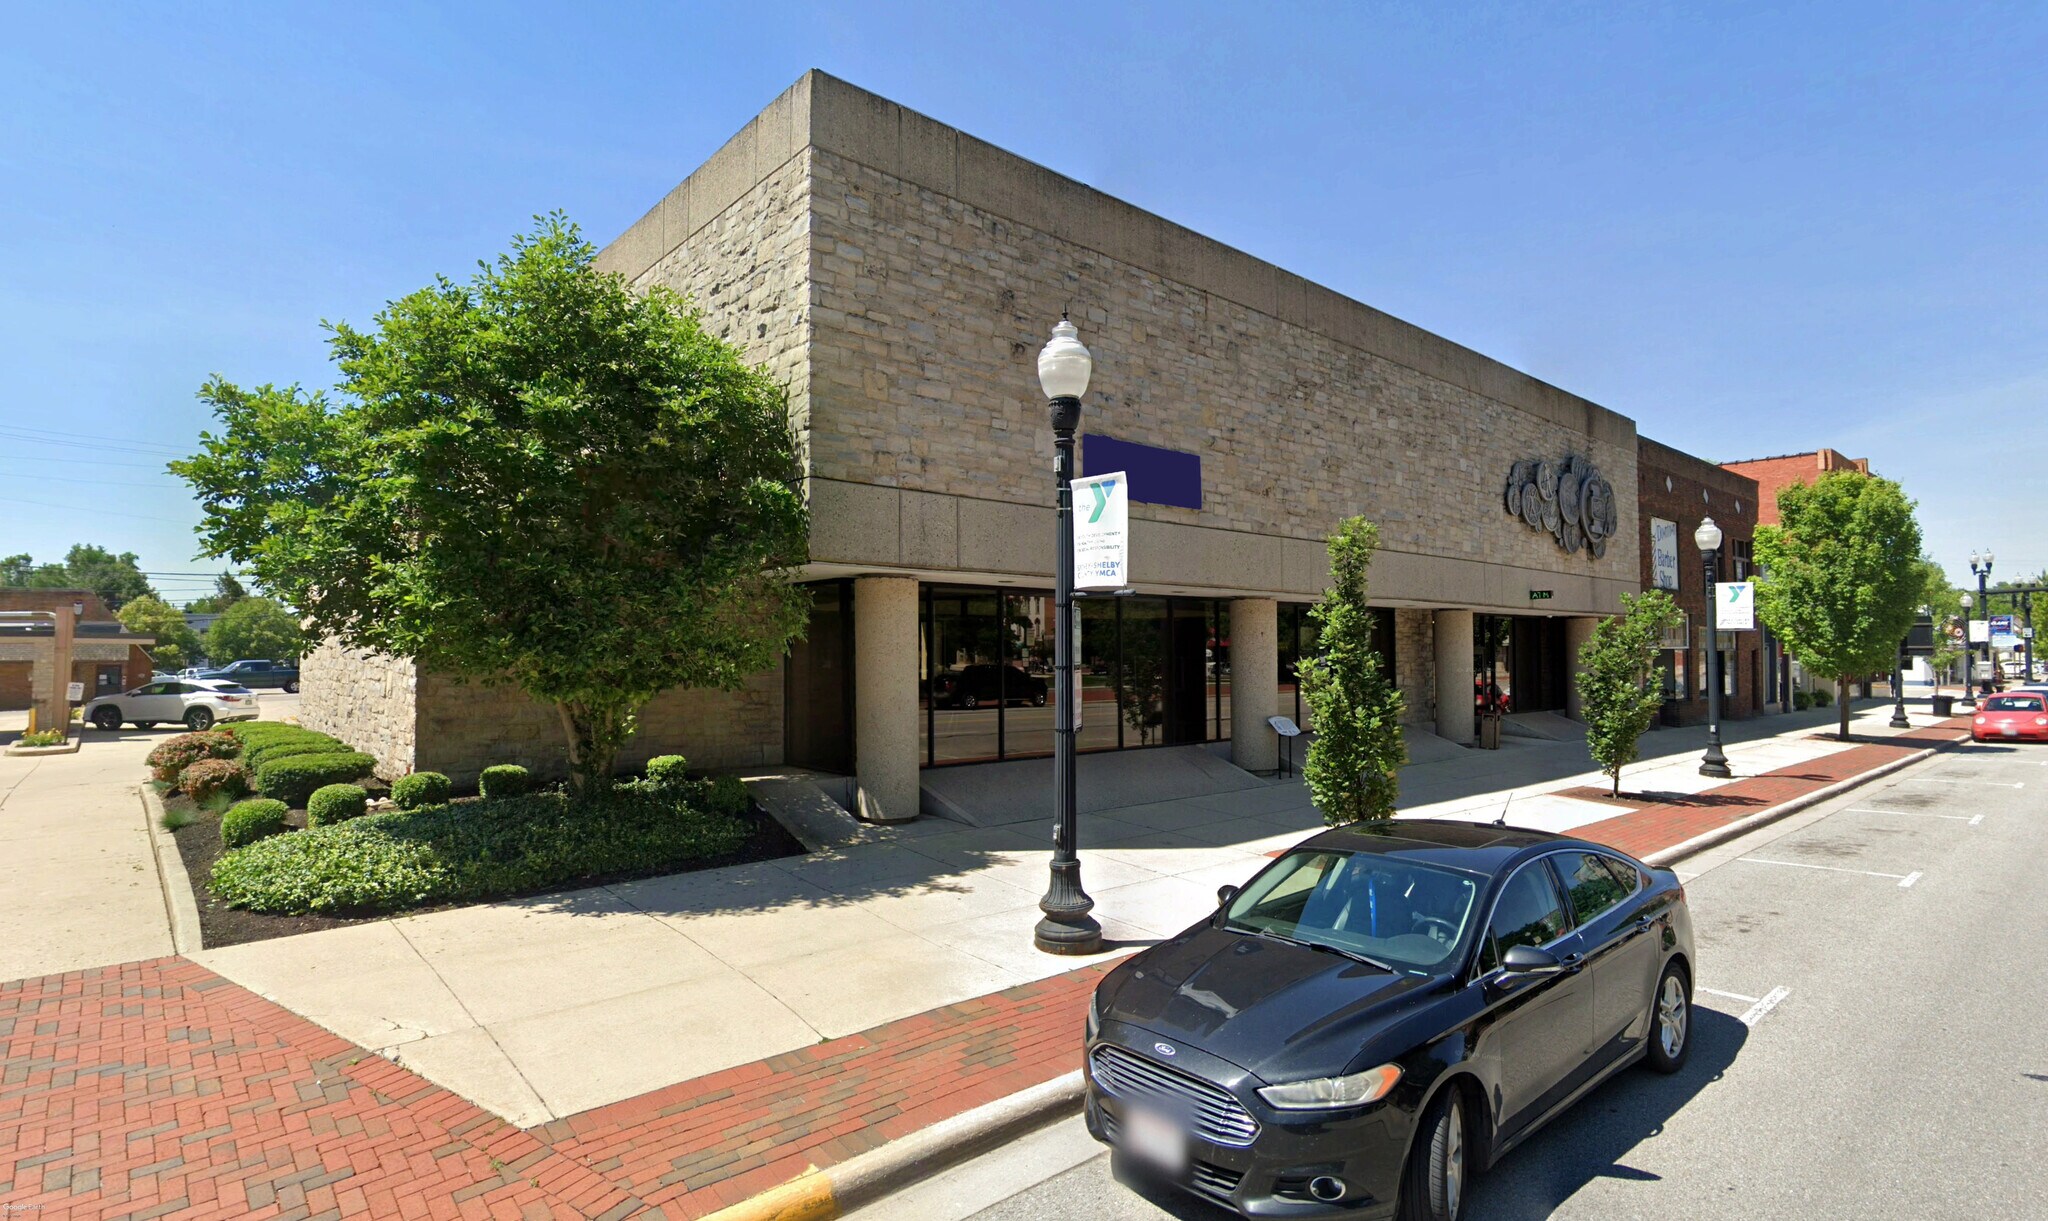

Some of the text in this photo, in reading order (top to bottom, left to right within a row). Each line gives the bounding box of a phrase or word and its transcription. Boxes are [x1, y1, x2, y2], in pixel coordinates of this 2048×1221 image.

[1657, 548, 1675, 568] Barber
[1095, 569, 1117, 577] YMCA
[1659, 570, 1673, 588] Shop
